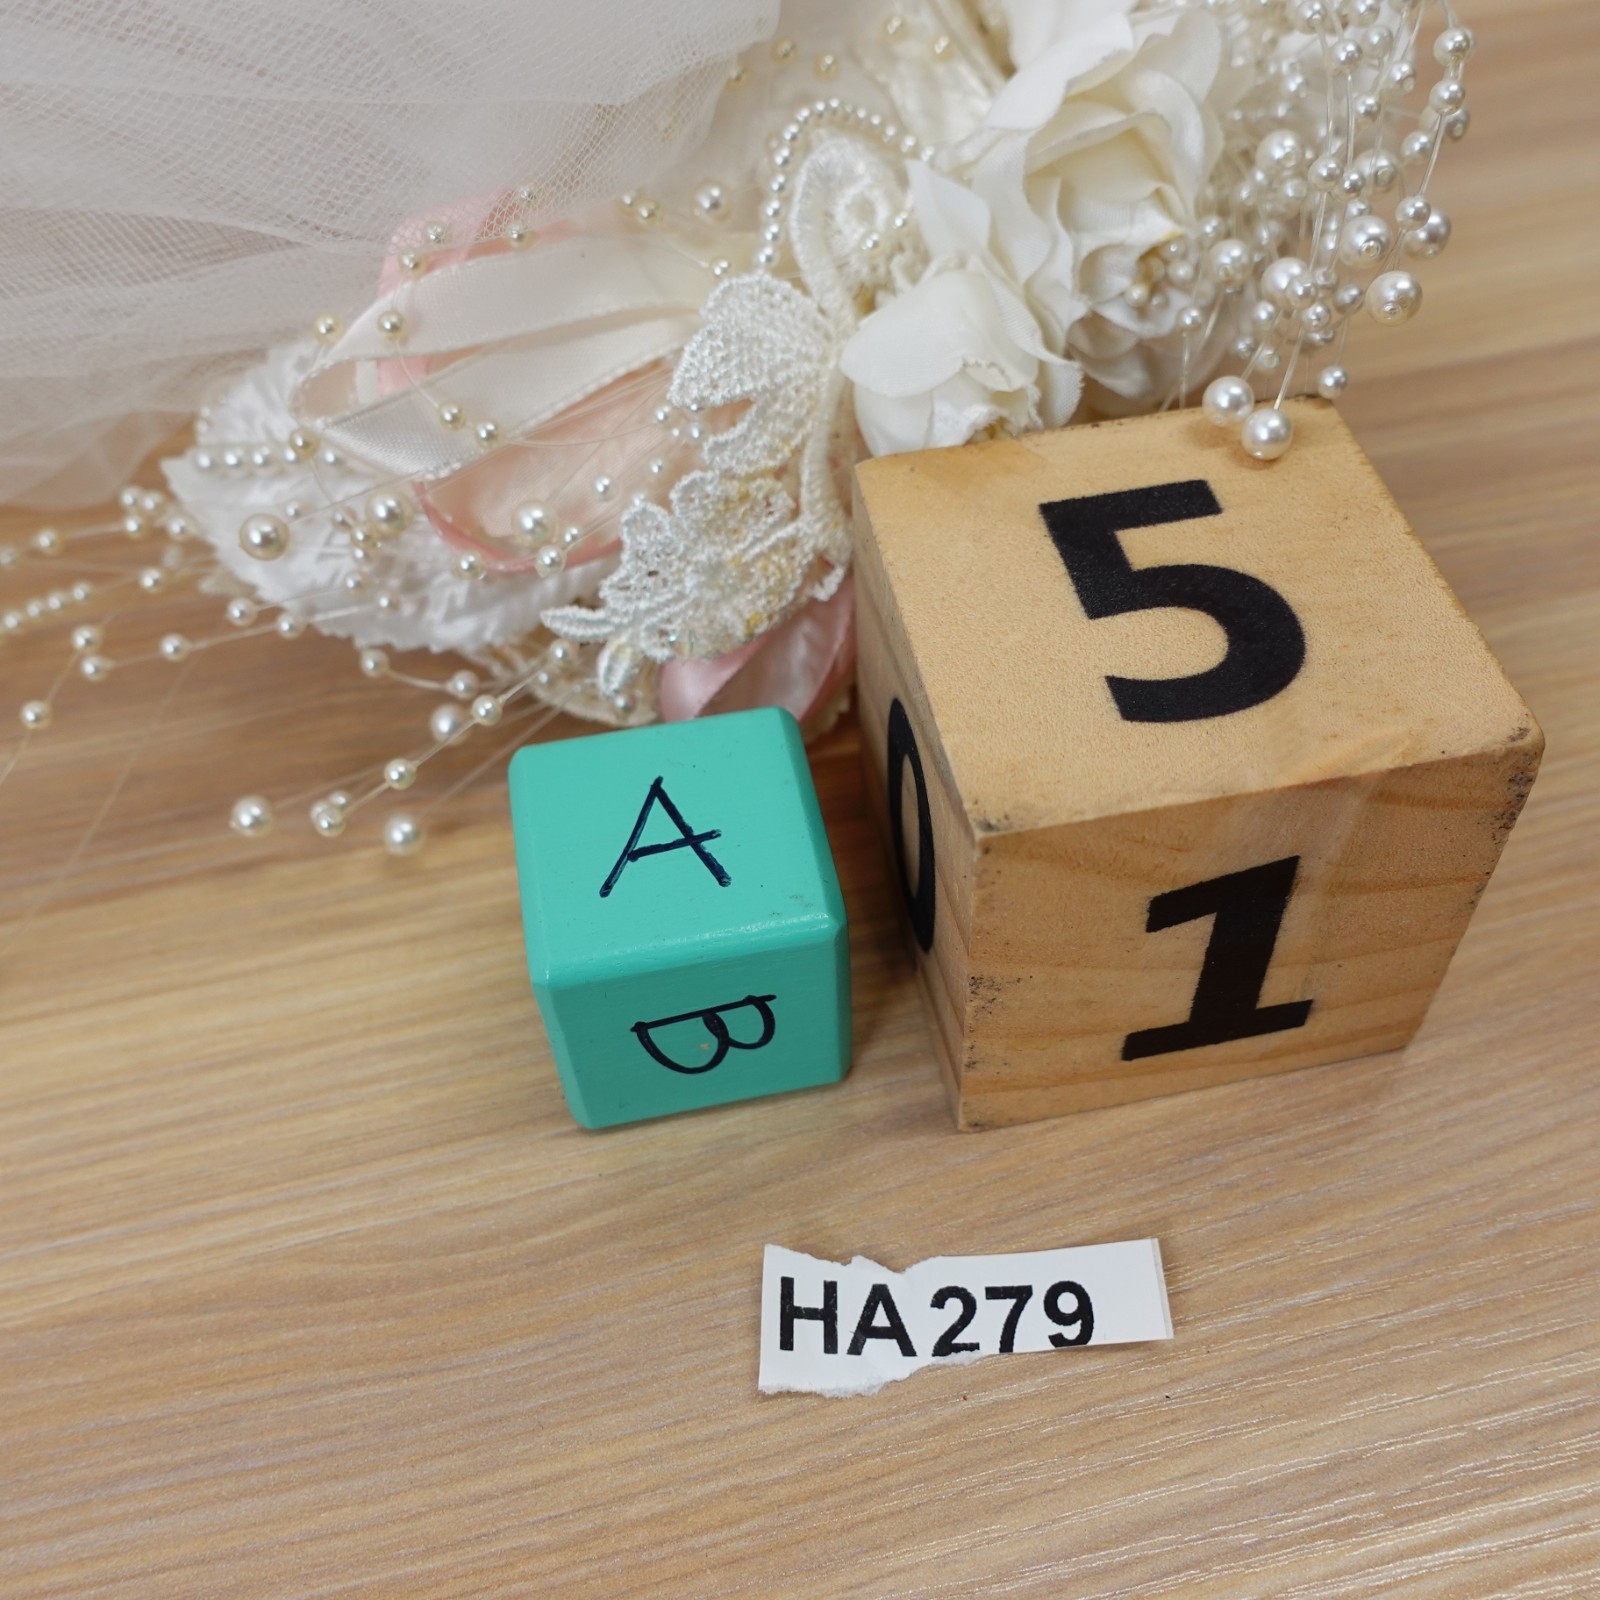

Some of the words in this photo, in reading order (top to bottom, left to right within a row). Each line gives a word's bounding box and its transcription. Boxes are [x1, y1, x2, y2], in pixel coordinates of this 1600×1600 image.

[1039, 480, 1305, 723] 5
[599, 776, 731, 898] A
[1121, 855, 1314, 1062] 1
[630, 994, 778, 1075] B
[779, 1276, 1095, 1357] HA279
